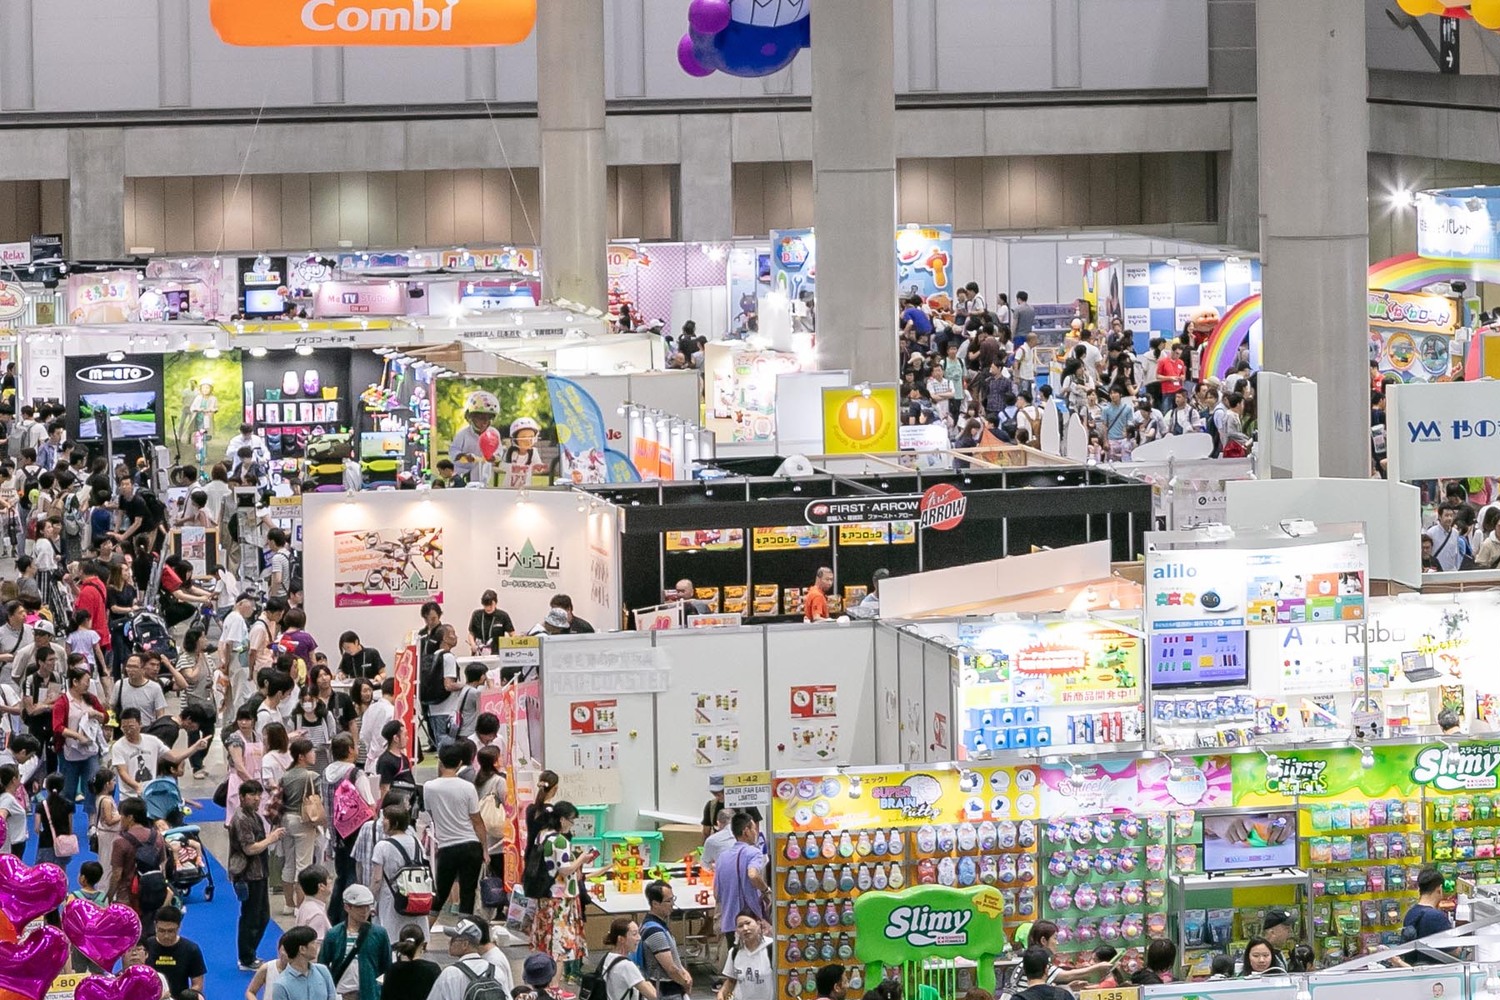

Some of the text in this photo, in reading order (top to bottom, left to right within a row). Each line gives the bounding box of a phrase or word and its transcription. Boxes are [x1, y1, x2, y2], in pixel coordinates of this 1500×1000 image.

[301, 0, 453, 32] Combi
[830, 501, 919, 514] FIRST ARROW
[920, 497, 967, 529] ARROW
[1153, 563, 1197, 579] alilo
[737, 775, 758, 783] 1-42
[872, 786, 912, 798] SUPER
[880, 797, 917, 810] BRAIN
[885, 905, 972, 943] Slimy
